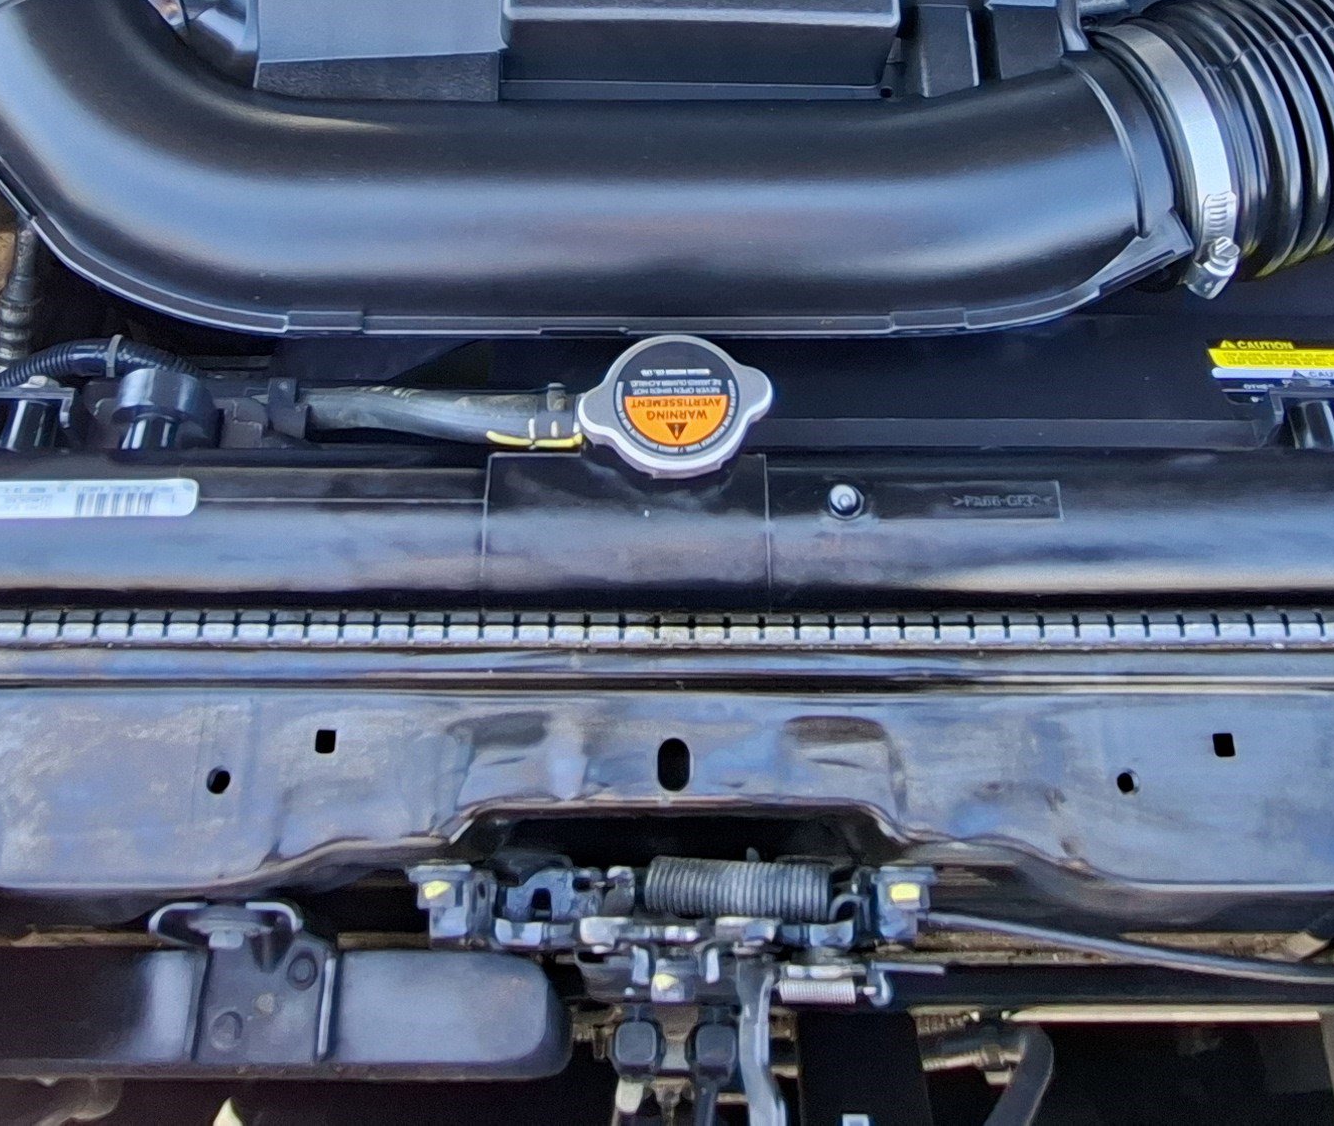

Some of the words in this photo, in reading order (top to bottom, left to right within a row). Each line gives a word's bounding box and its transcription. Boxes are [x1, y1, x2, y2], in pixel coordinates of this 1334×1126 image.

[1237, 340, 1294, 350] CAUTION
[630, 397, 722, 408] AVERTISSEMENT
[646, 410, 708, 421] WARNING
